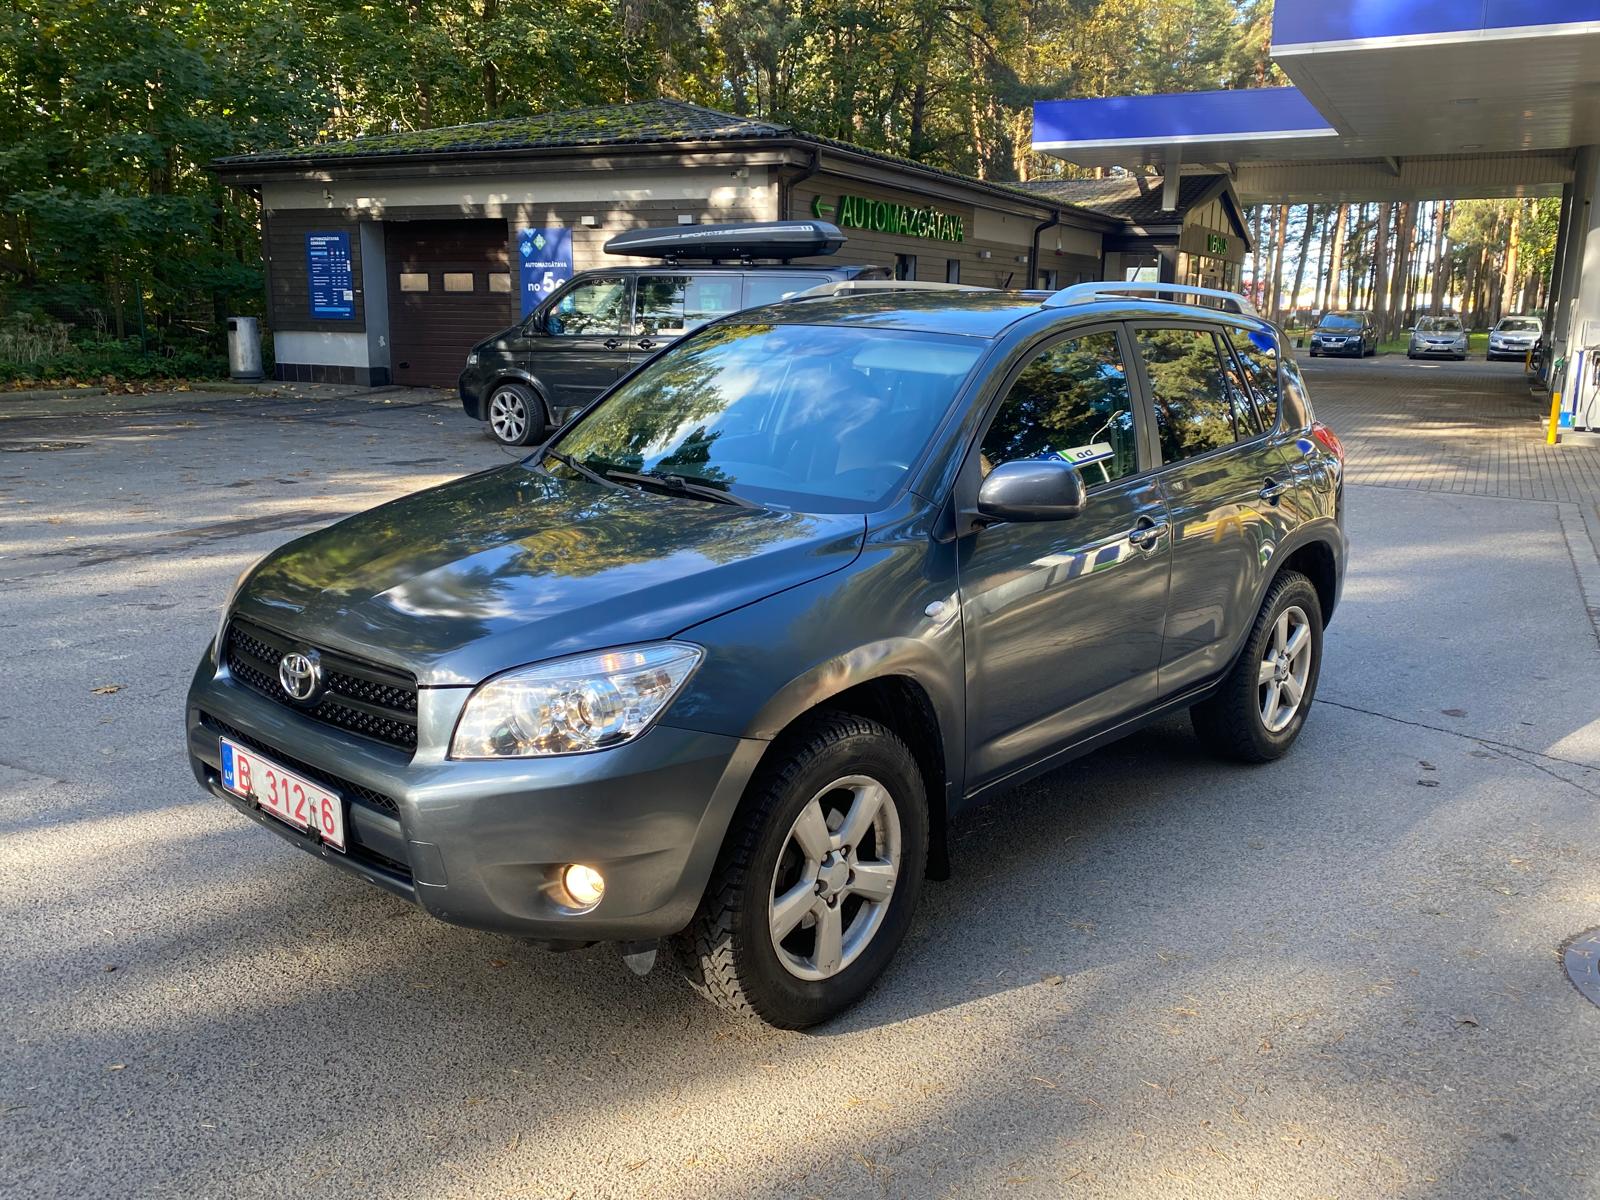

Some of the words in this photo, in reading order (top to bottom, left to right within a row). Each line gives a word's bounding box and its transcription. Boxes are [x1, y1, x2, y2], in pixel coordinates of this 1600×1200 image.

[839, 194, 964, 242] AUTOMAZGĀTAVA
[528, 283, 540, 291] no
[225, 769, 233, 780] LV
